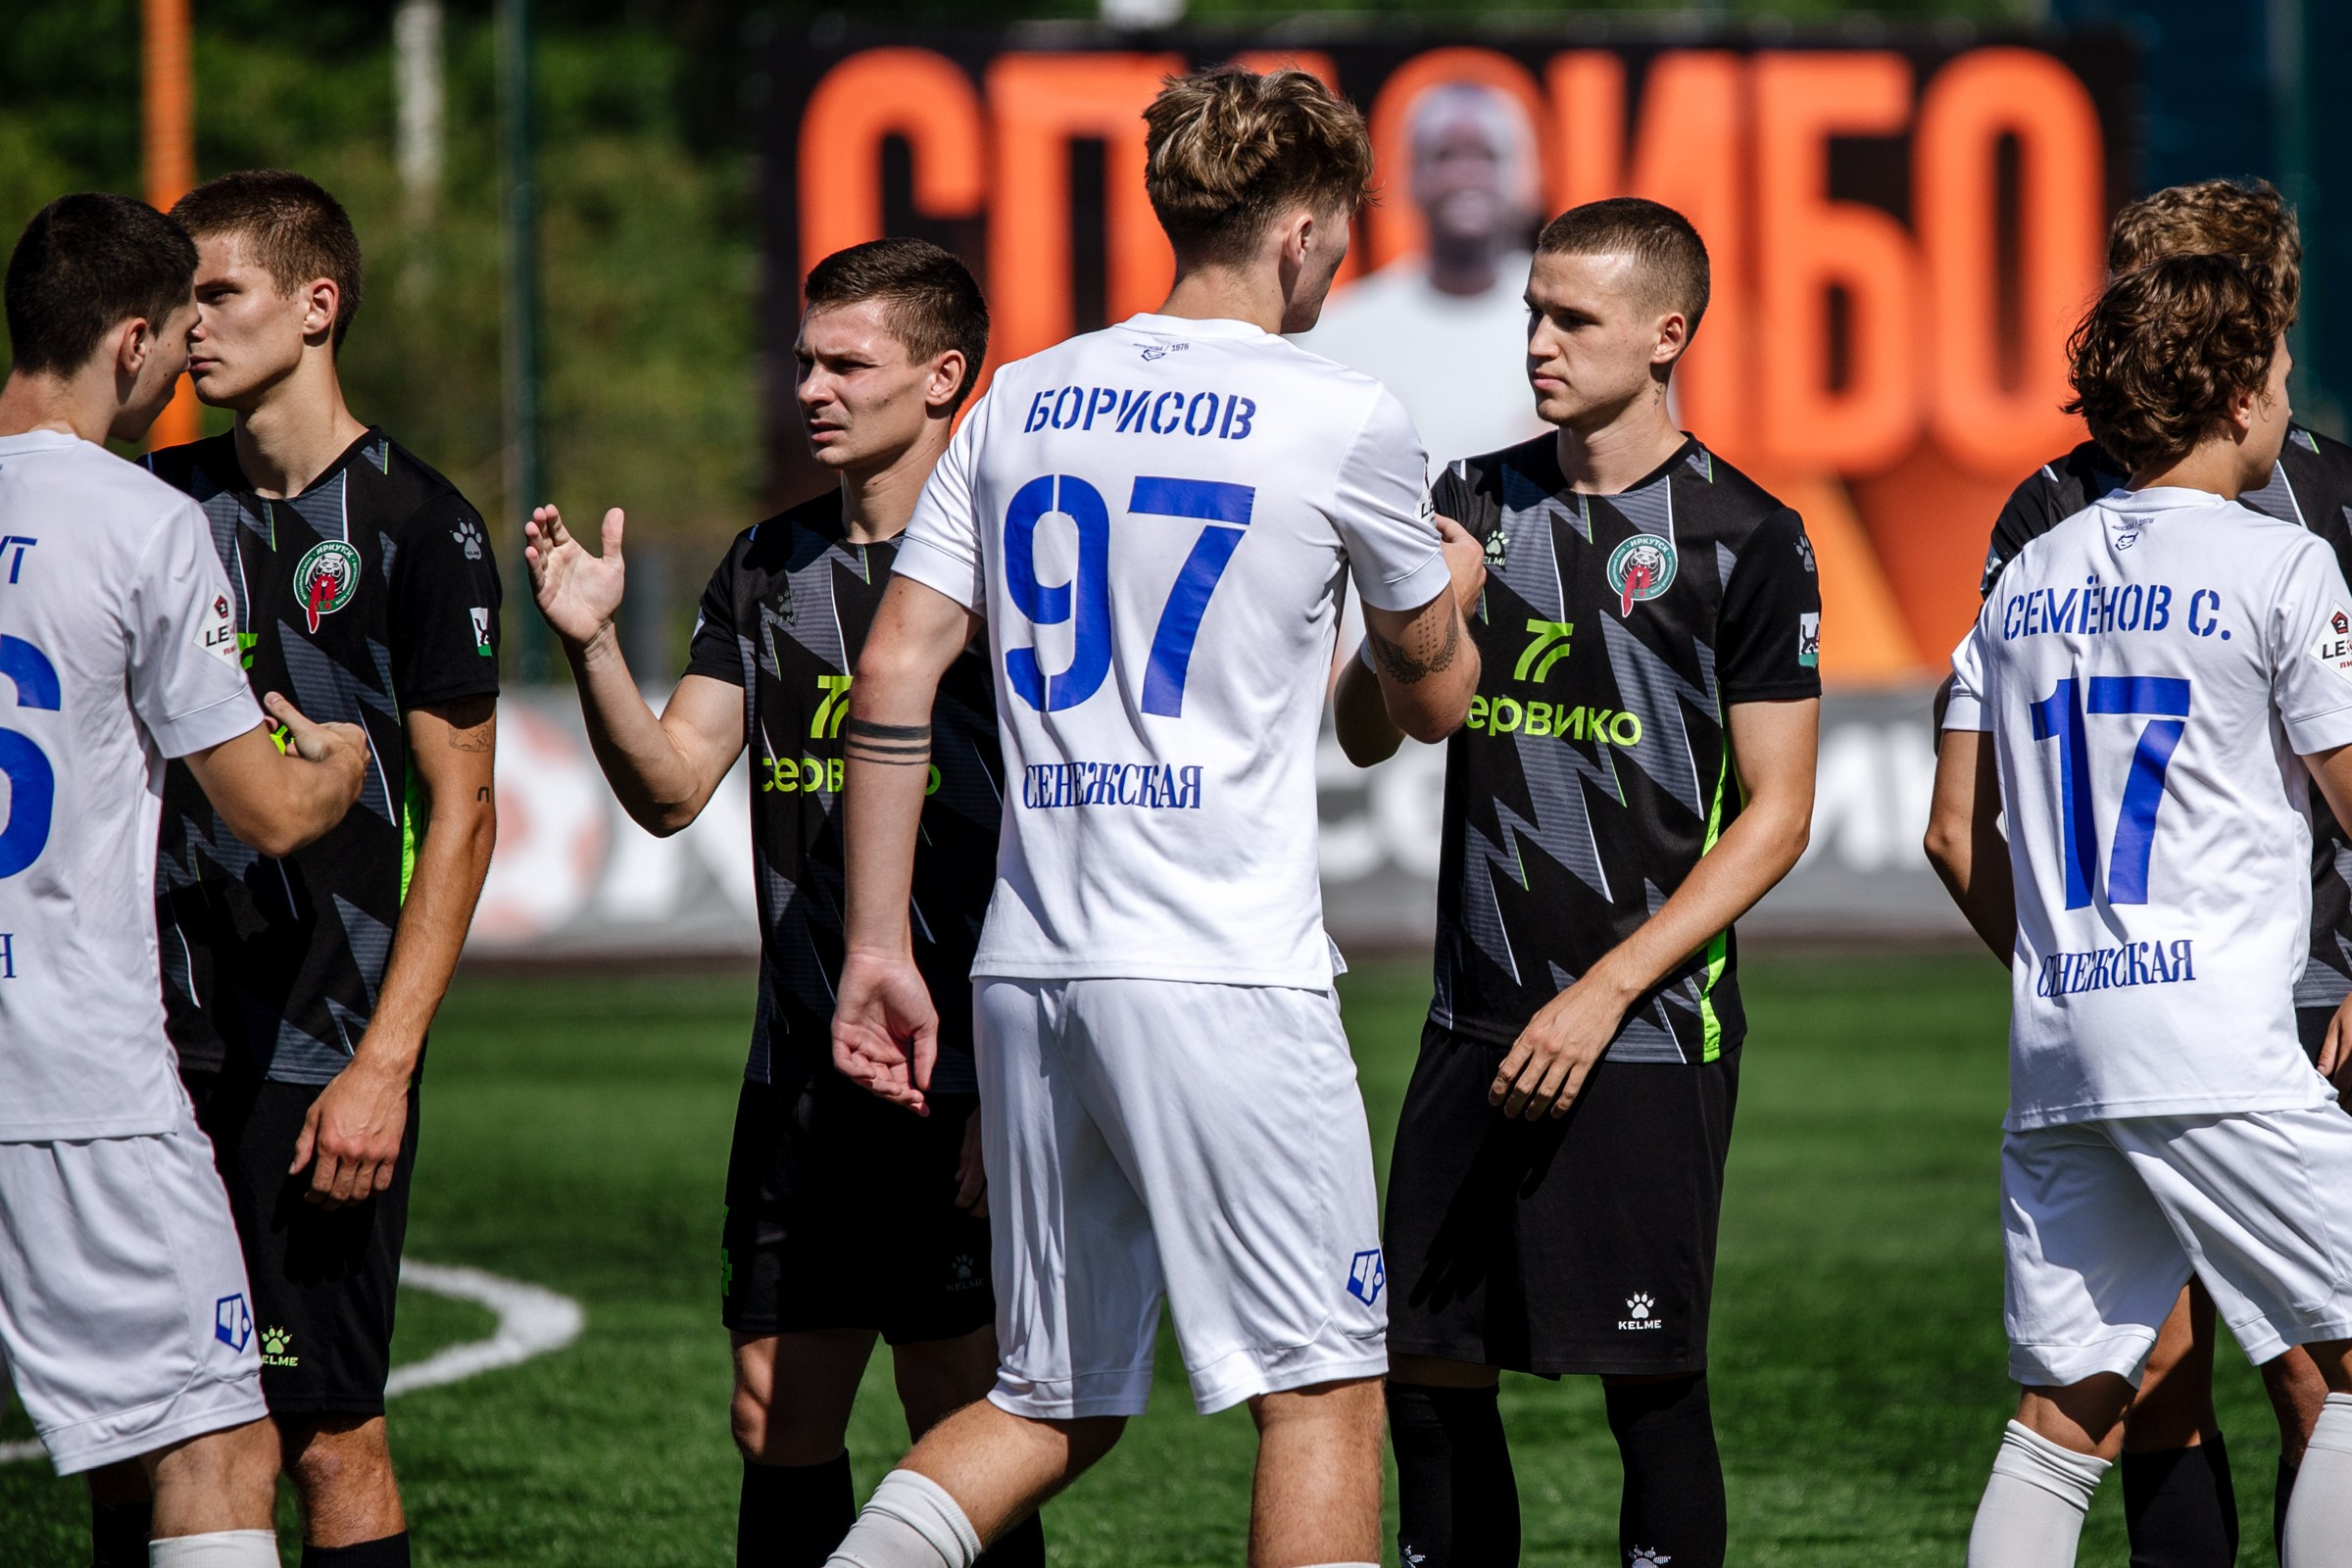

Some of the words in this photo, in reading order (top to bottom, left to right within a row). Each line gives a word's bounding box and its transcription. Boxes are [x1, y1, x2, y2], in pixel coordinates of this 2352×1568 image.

[797, 46, 2104, 472] СПСИБО
[1024, 385, 1256, 440] БОРИСОВ
[317, 544, 354, 559] ИРКУТСК
[1483, 556, 1506, 565] ELM
[1630, 537, 1671, 553] ИРКУТСК
[1004, 473, 1256, 719] 97
[2004, 574, 2171, 641] СЕМЁНОВ
[2188, 588, 2231, 641] С.
[1467, 694, 1642, 747] ервико
[1023, 761, 1203, 809] СЕНЕЖСКАЯ
[2031, 676, 2191, 910] 17
[1618, 1319, 1662, 1330] KELME
[262, 1354, 299, 1366] ELME
